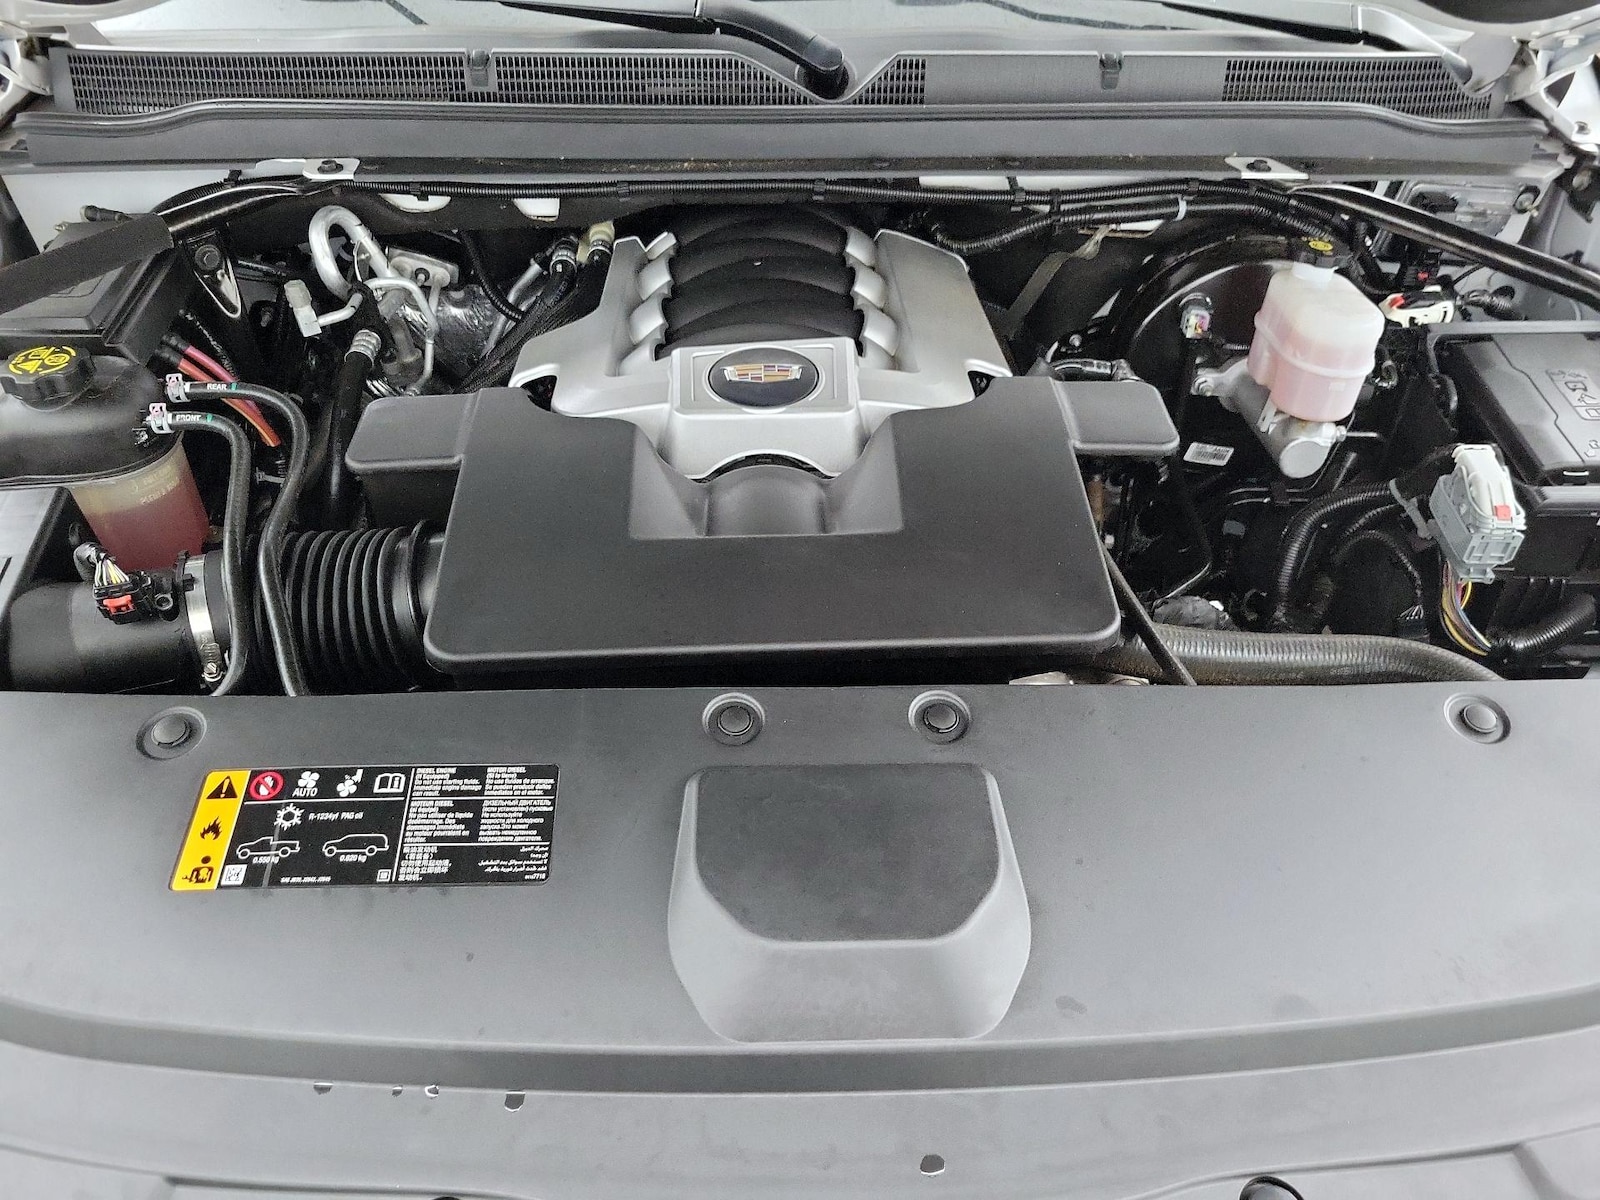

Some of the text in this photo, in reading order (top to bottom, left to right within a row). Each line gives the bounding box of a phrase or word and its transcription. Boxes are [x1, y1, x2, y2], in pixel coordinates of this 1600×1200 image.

[175, 414, 202, 422] FRONT
[292, 788, 318, 797] AUTO
[340, 812, 354, 820] PAG
